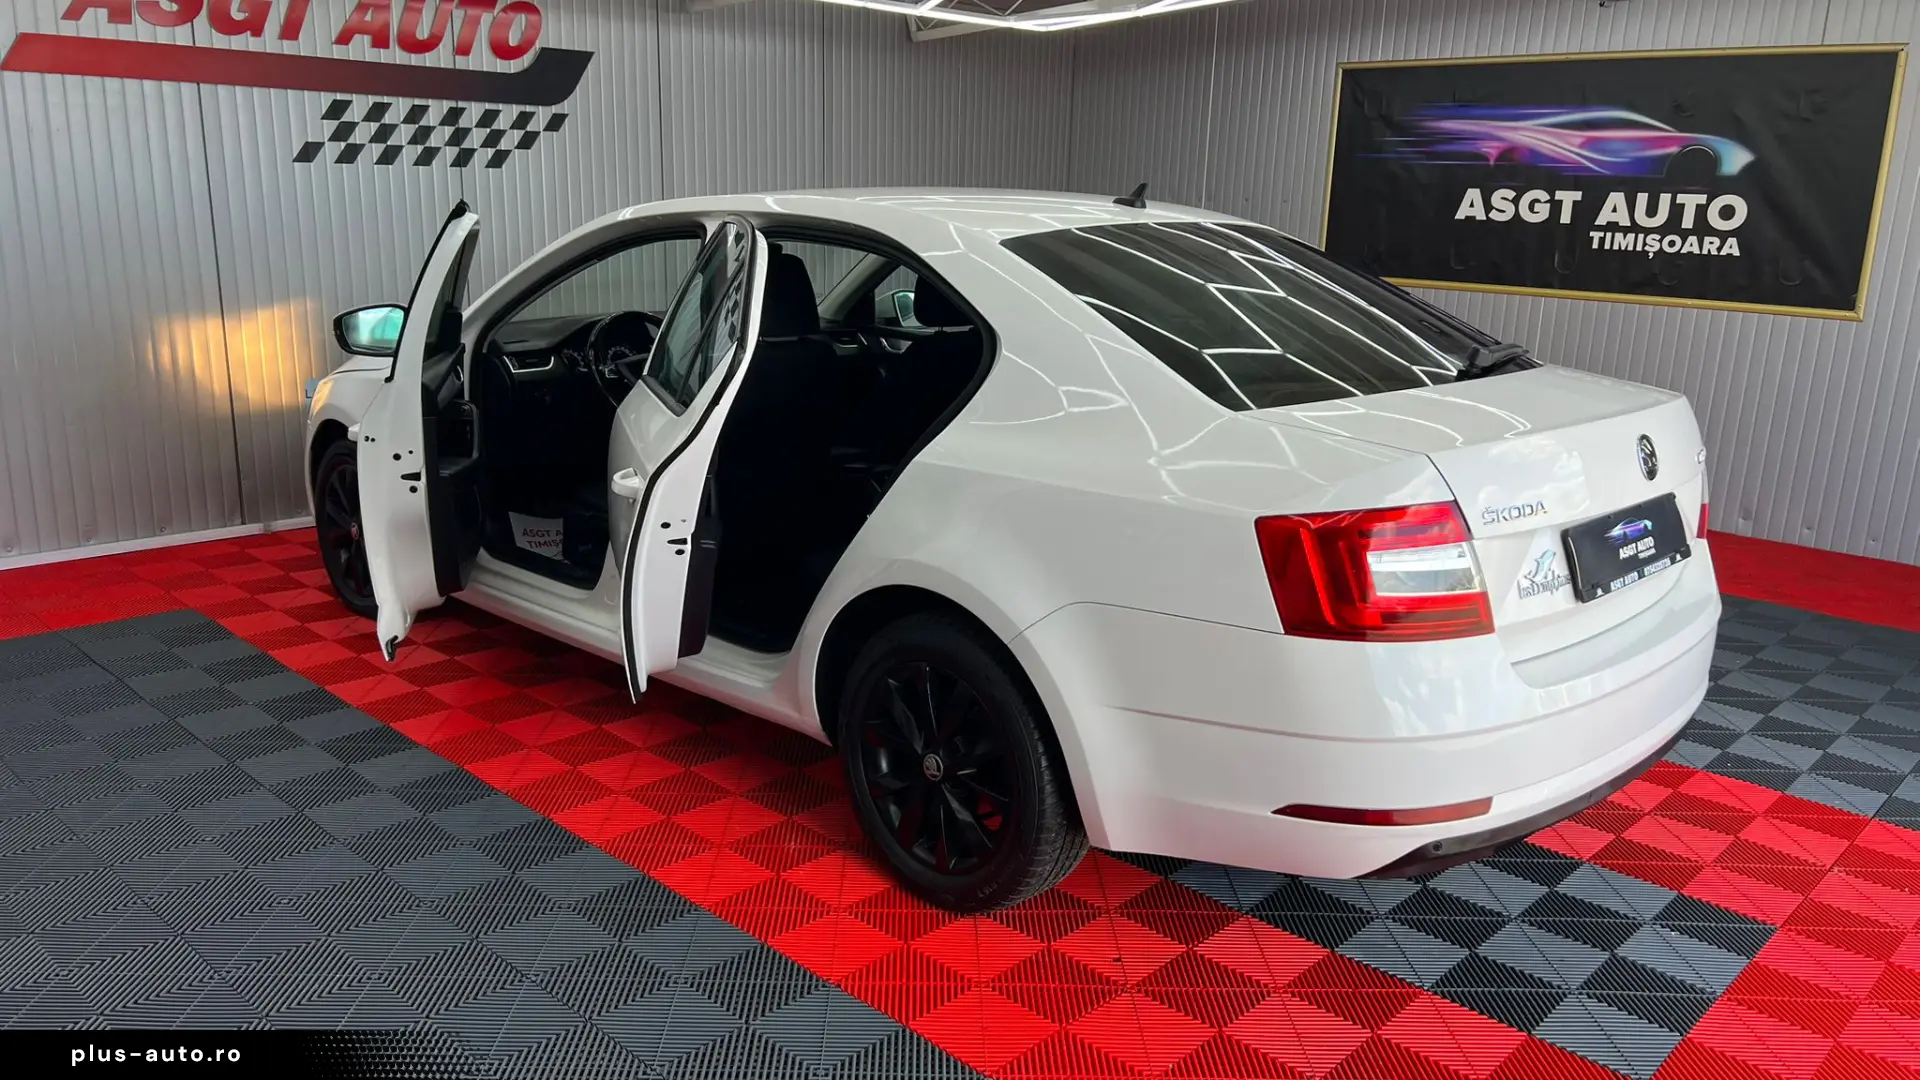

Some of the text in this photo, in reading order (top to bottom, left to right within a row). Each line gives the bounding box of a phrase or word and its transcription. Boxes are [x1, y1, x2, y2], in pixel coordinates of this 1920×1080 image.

[333, 0, 542, 61] AUTO
[1454, 188, 1748, 231] ASGT AUTO
[1589, 231, 1741, 259] TIMIȘOARA
[1482, 500, 1547, 525] ŠKODA
[522, 528, 552, 538] ASGT
[1619, 542, 1637, 560] ASGT
